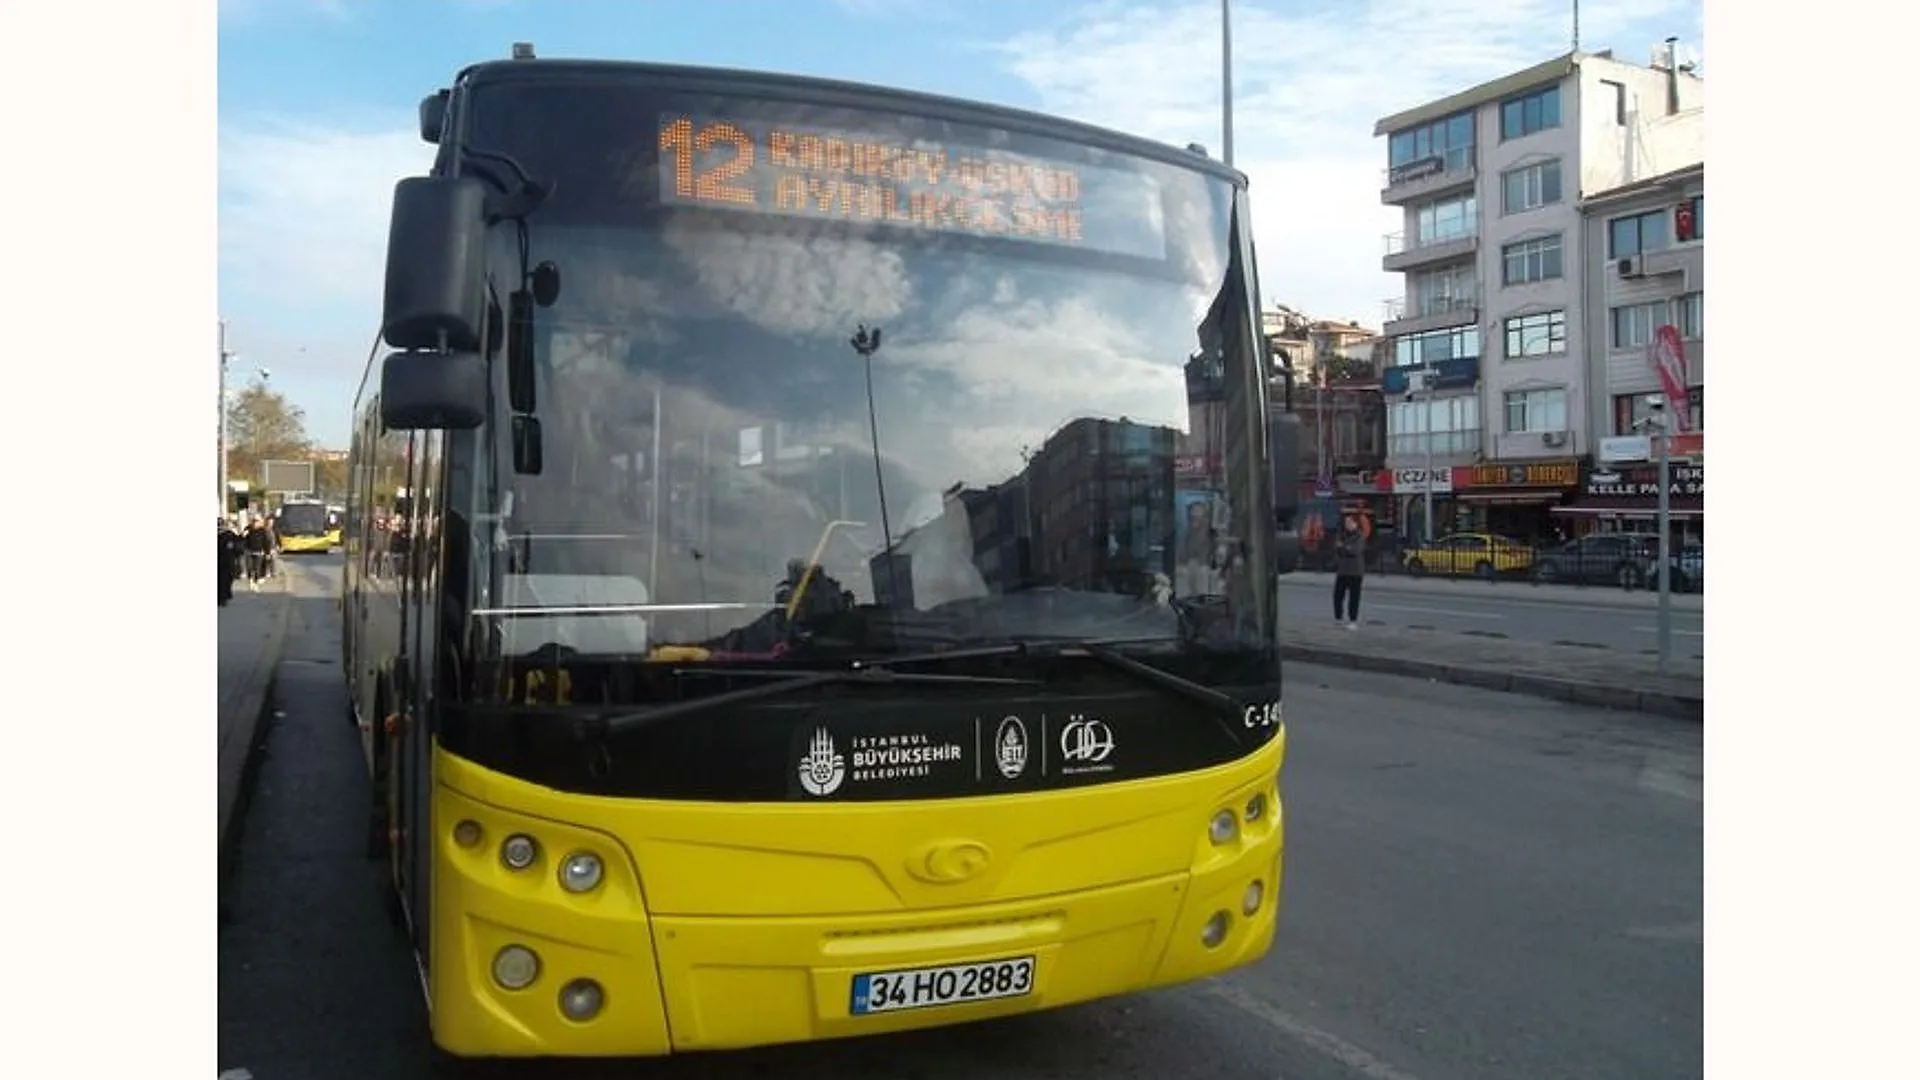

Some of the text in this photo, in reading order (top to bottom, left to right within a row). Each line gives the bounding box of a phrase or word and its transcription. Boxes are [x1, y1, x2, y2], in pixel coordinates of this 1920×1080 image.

[659, 117, 755, 202] 12
[1587, 483, 1637, 495] KELLE
[1640, 483, 1681, 495] PAA
[871, 976, 906, 1007] 34
[913, 971, 957, 1003] HO
[959, 960, 1031, 998] 2883
